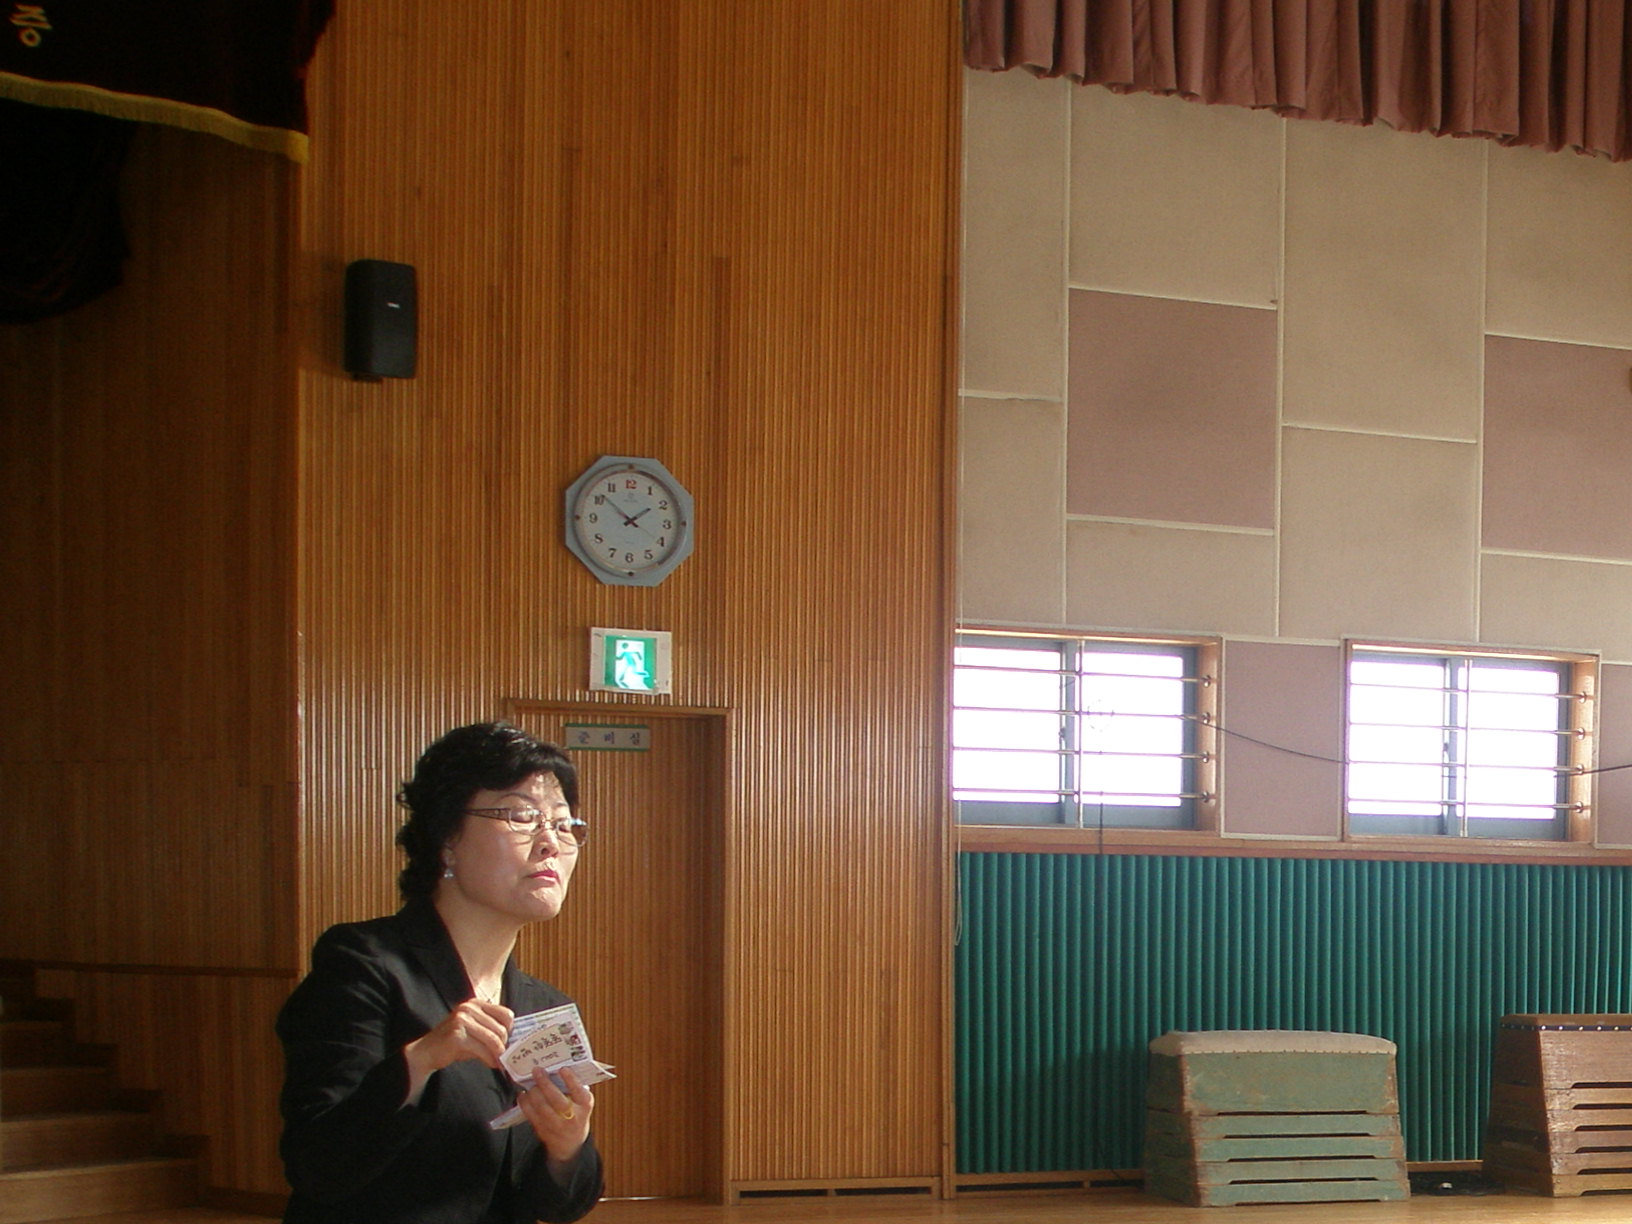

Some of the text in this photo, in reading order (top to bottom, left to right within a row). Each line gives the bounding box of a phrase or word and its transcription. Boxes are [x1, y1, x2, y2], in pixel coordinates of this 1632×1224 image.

[607, 483, 616, 493] 11
[625, 480, 637, 489] 12
[648, 486, 653, 496] 1
[594, 495, 605, 505] 10
[659, 500, 668, 510] 2
[589, 512, 598, 524] 9
[663, 520, 672, 530] 3
[595, 533, 604, 544] 8
[657, 537, 665, 547] 4
[608, 548, 617, 558] 7
[625, 552, 634, 563] 6
[644, 549, 653, 560] 5
